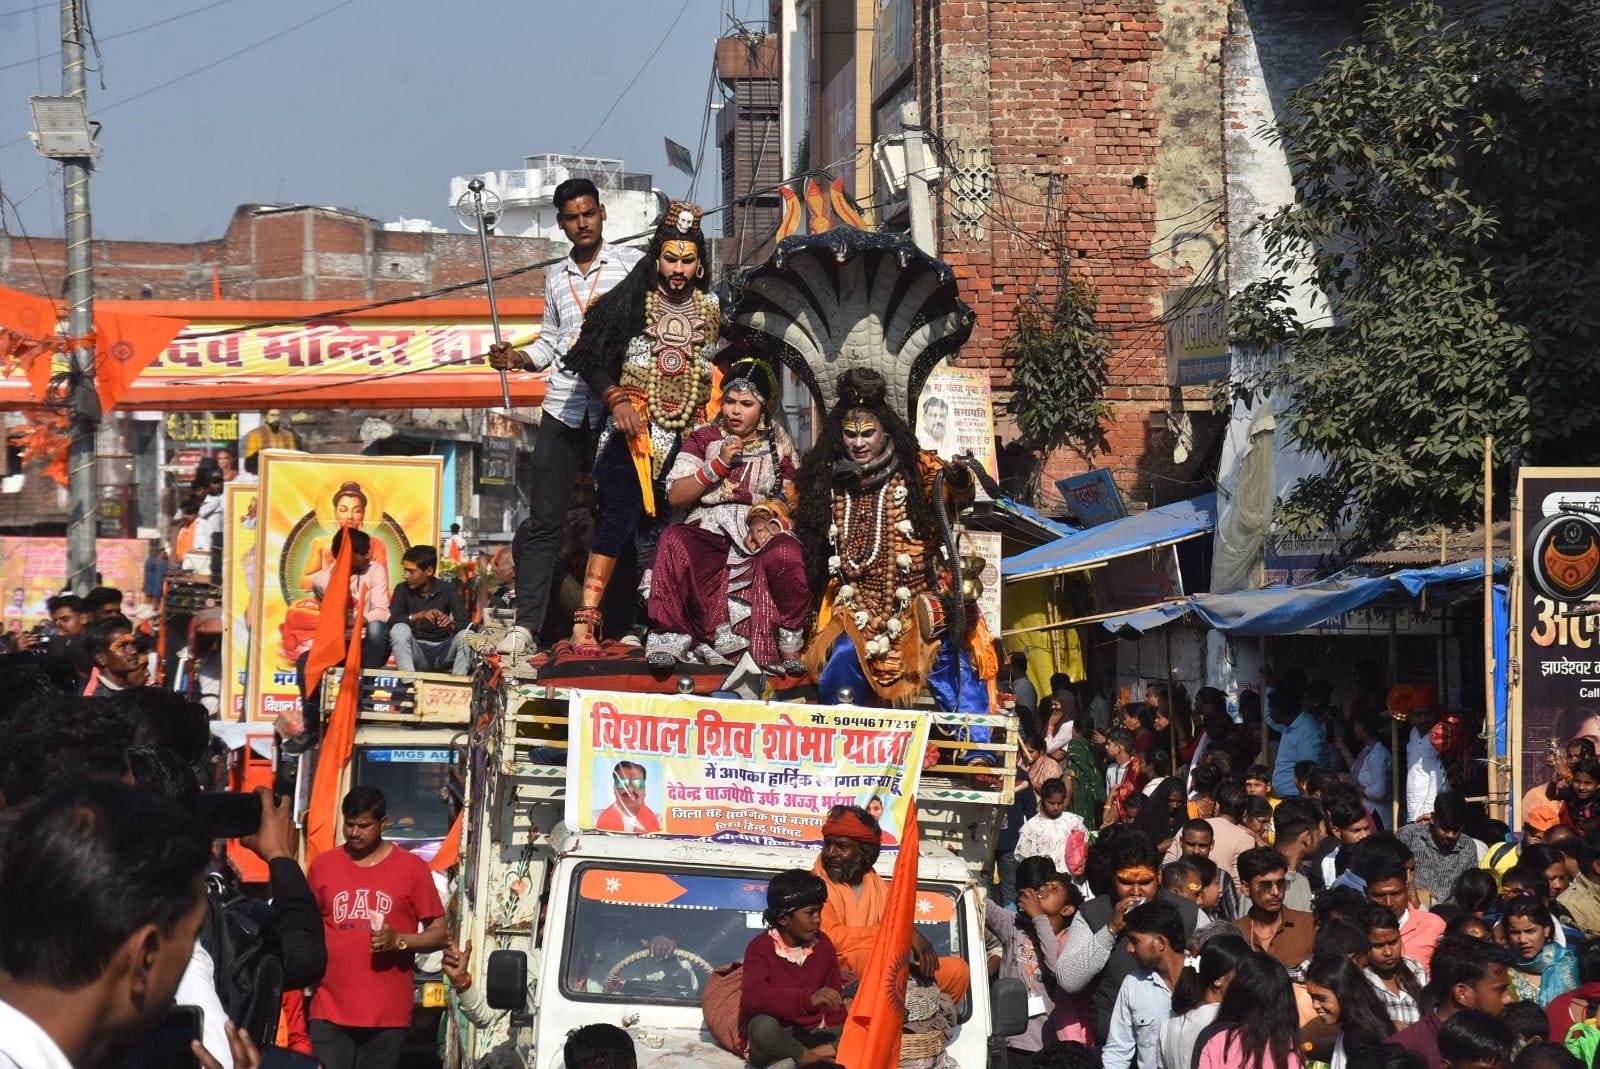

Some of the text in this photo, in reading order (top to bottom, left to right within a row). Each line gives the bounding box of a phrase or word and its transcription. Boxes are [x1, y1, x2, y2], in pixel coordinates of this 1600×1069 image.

[590, 701, 690, 754] विशाल
[695, 708, 757, 759] शिव
[761, 713, 837, 764] शोभा
[393, 751, 424, 759] MGS
[705, 763, 717, 779] में
[720, 767, 766, 783] आपका
[768, 767, 812, 789] हार्दिक
[667, 781, 701, 801] देवेन्द्र
[704, 783, 755, 803] बाजपेयी
[757, 789, 780, 806] उर्फ
[784, 793, 819, 813] अज्जू
[333, 889, 392, 924] GAP
